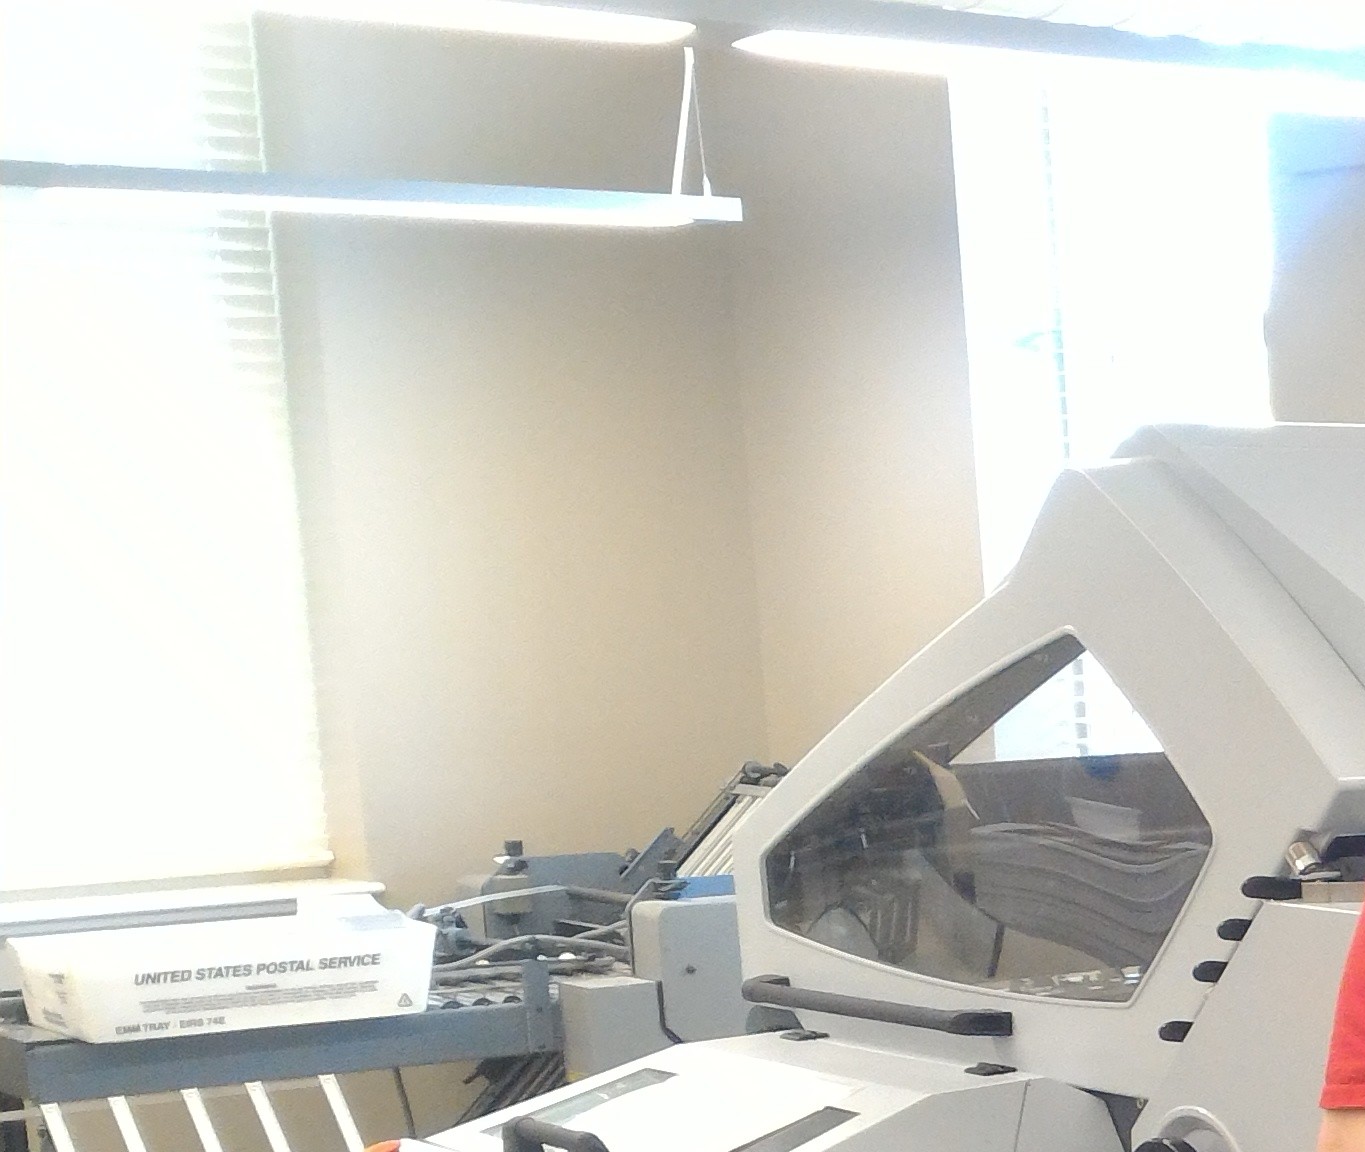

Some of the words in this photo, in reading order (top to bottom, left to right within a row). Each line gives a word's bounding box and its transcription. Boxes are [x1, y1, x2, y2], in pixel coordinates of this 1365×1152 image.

[134, 969, 193, 986] UNITED
[195, 963, 253, 981] STATES
[256, 959, 315, 976] POSTAL
[318, 953, 382, 970] SERVICE
[142, 1021, 171, 1032] TRAY
